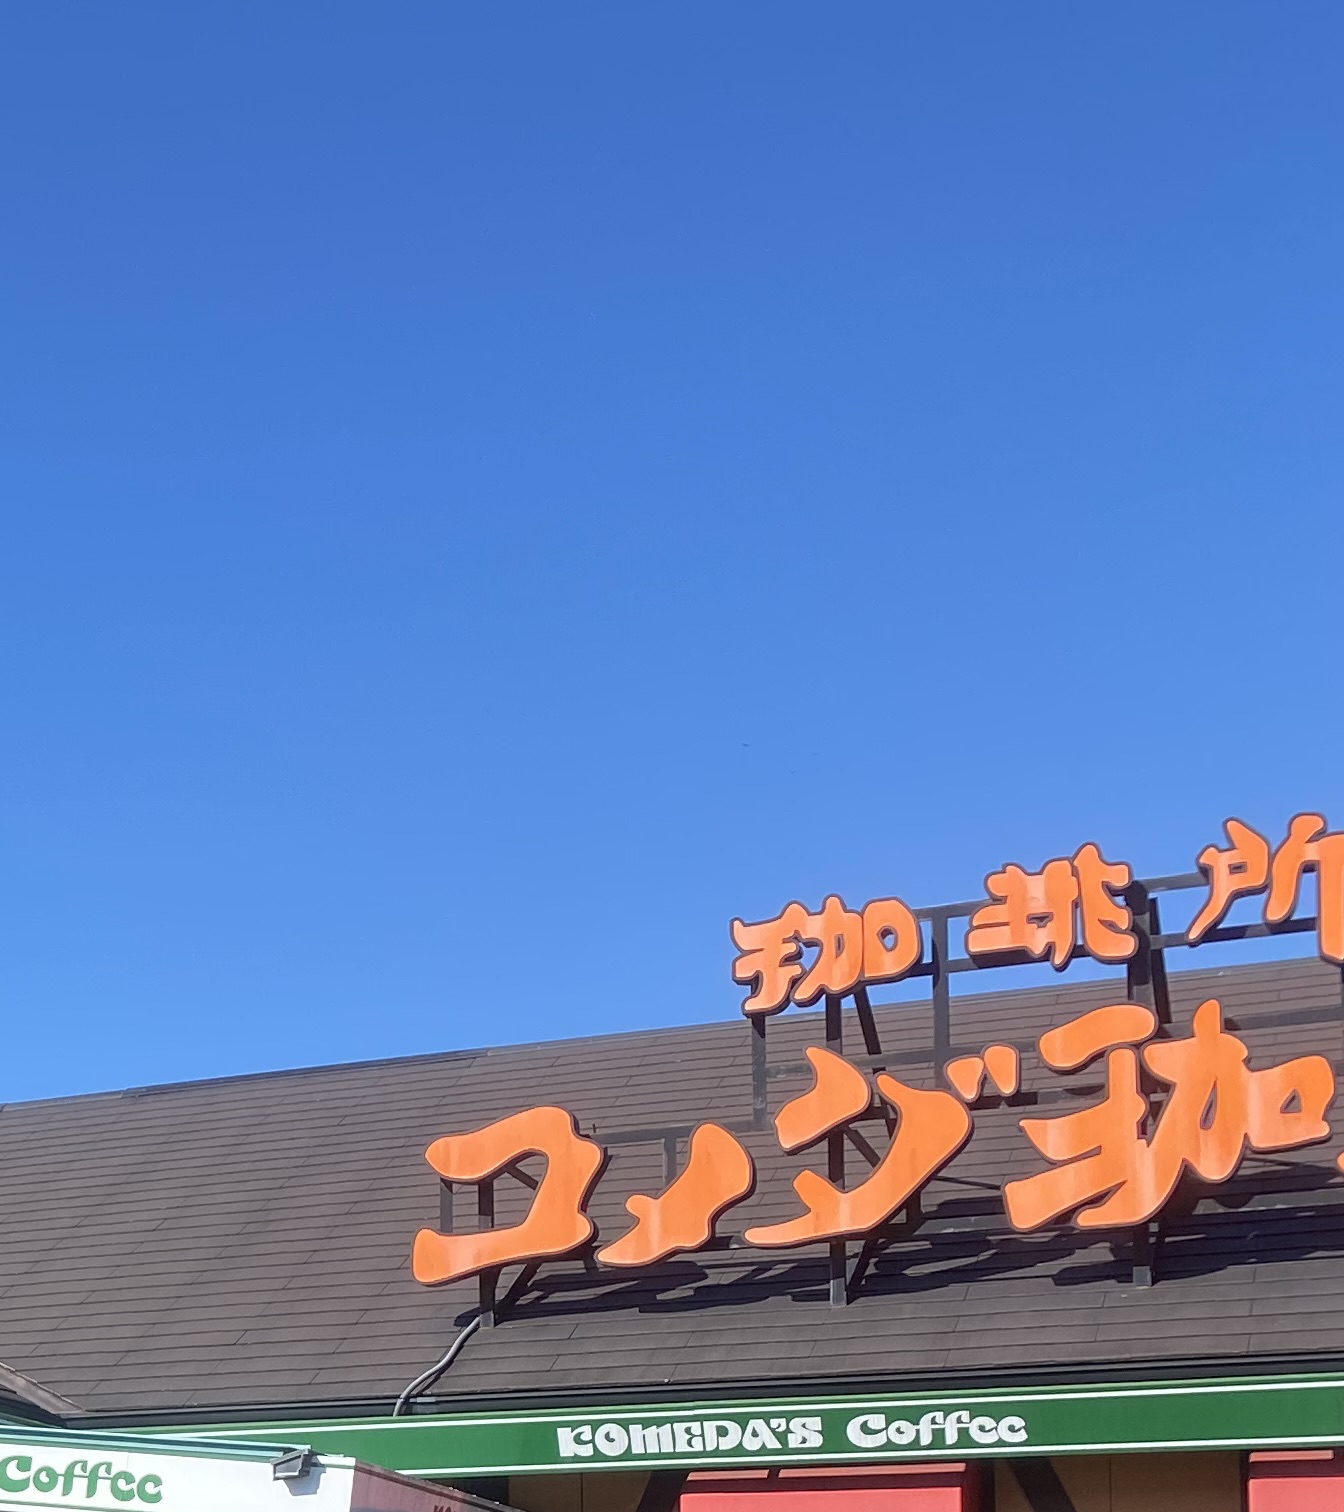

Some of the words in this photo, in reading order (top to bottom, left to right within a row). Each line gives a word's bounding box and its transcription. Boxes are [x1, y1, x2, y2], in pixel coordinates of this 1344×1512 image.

[410, 999, 1344, 1286] コメダ珈
[556, 1416, 823, 1457] KOMEDA'S
[846, 1410, 1028, 1448] Coffee
